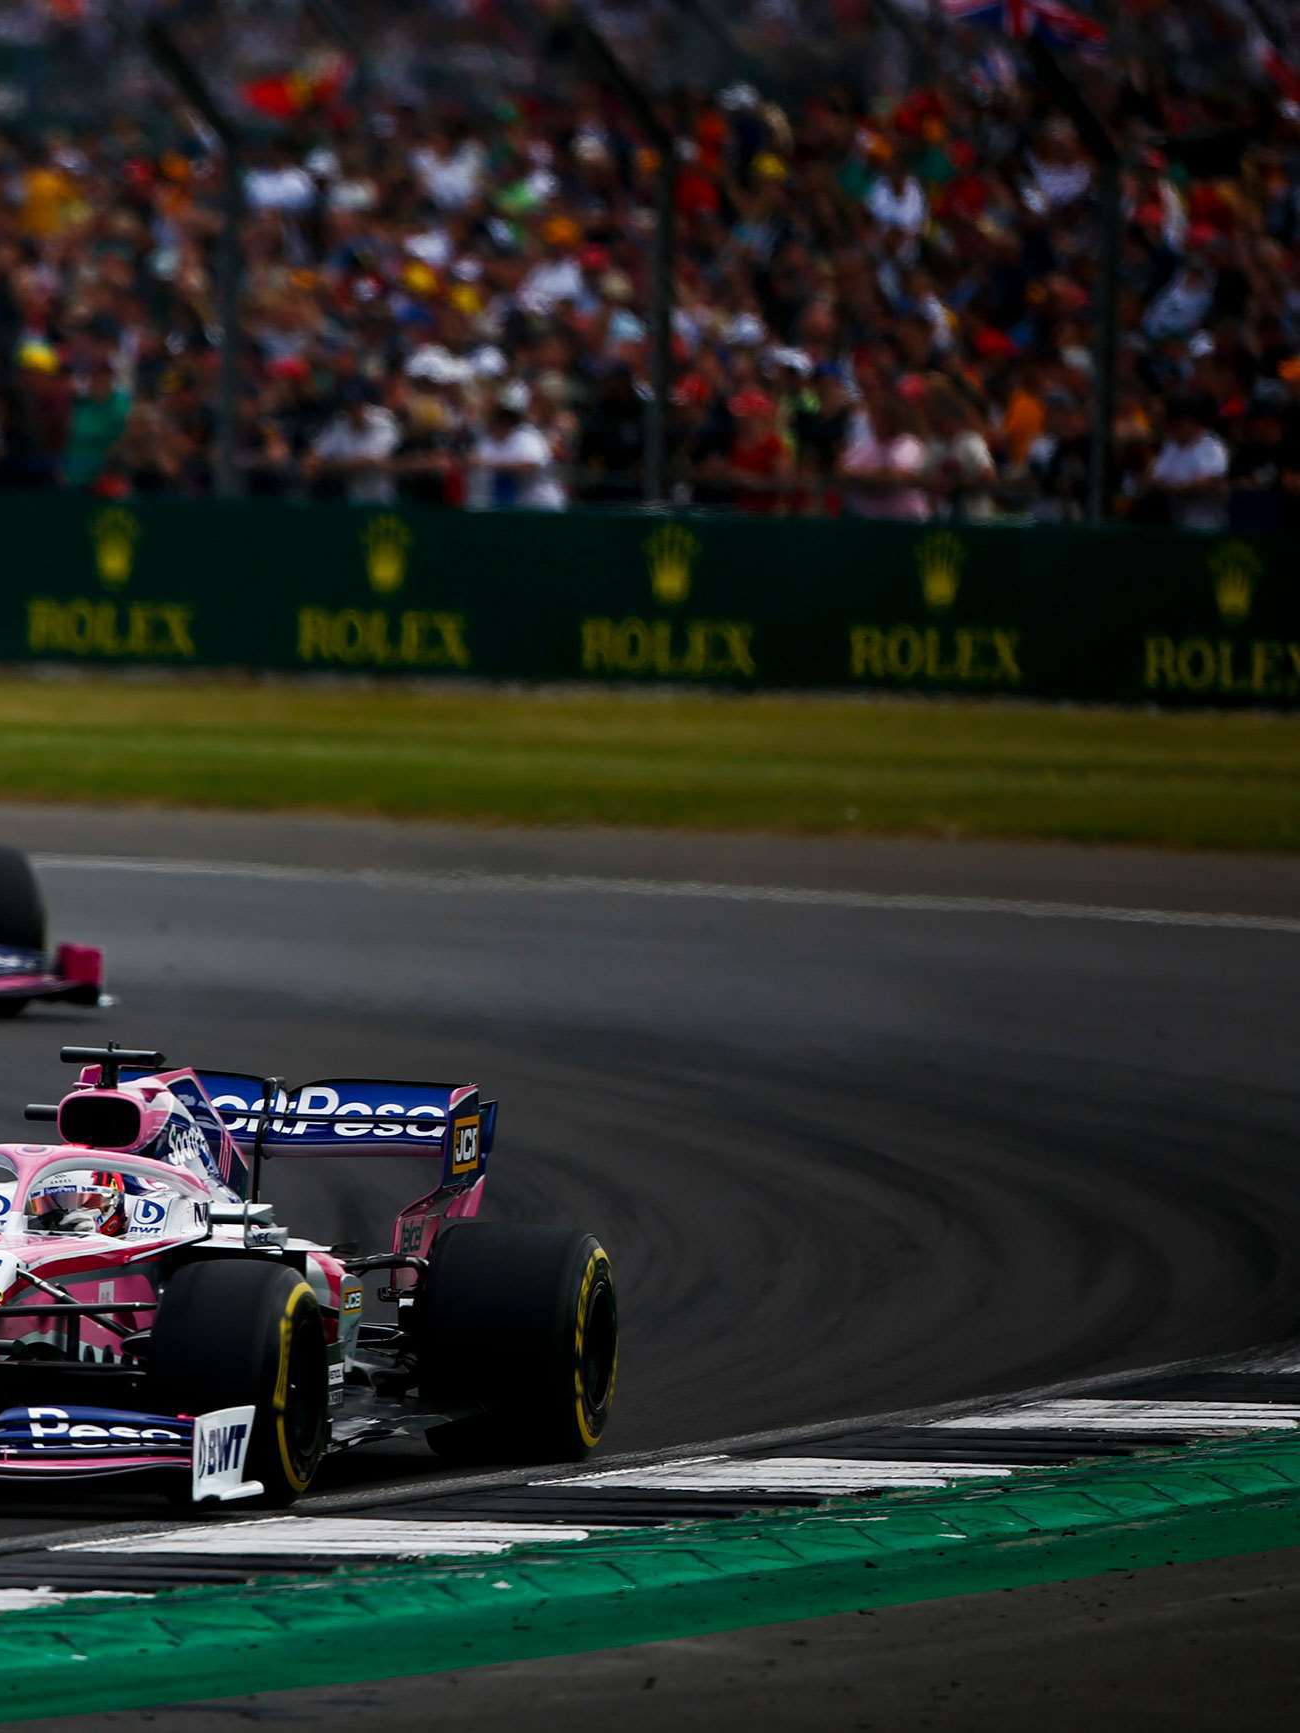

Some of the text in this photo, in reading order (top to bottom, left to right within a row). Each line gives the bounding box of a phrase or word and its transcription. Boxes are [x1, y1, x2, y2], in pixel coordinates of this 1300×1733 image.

[28, 599, 195, 655] ROLEX
[298, 607, 469, 665] ROLEX
[581, 617, 756, 675] ROLEX
[849, 627, 1021, 680] ROLEX
[212, 1086, 447, 1138] ortPesa
[28, 1407, 182, 1449] Pesa
[206, 1424, 247, 1475] BWT
